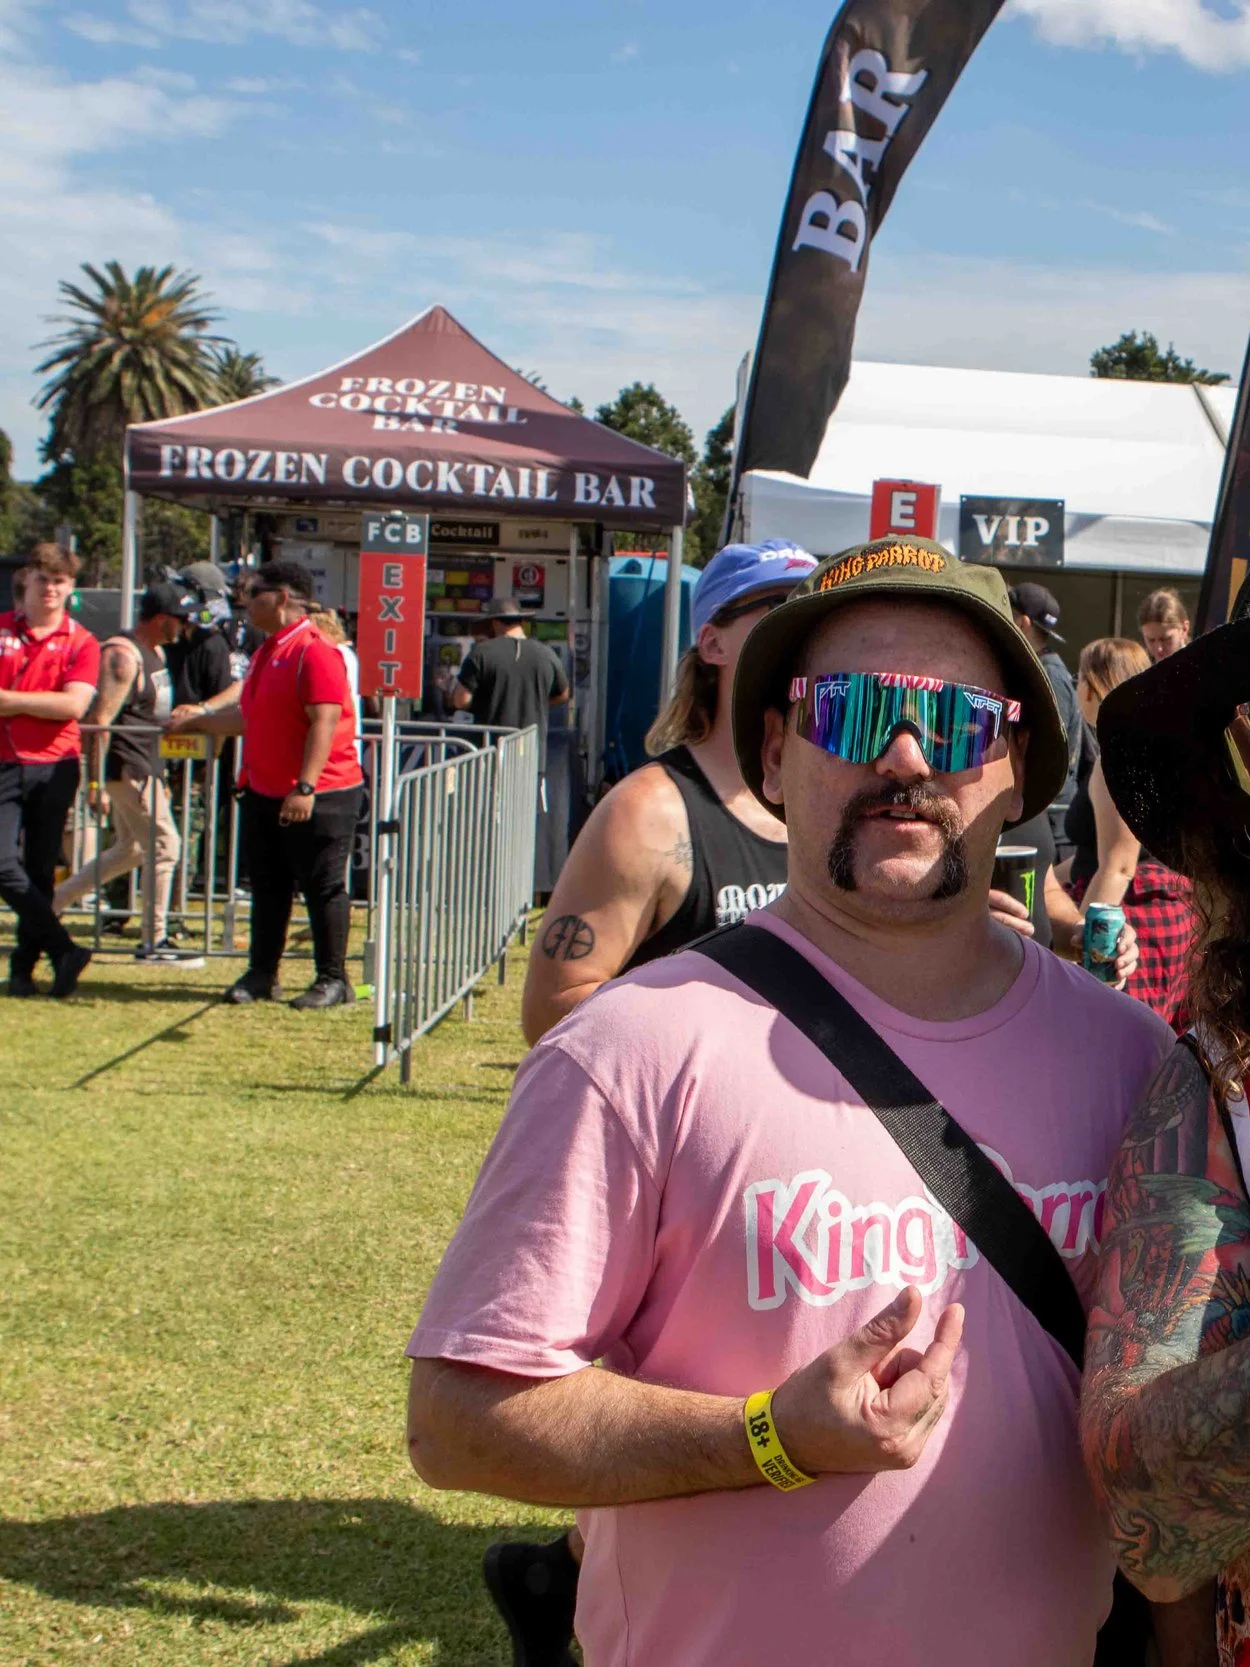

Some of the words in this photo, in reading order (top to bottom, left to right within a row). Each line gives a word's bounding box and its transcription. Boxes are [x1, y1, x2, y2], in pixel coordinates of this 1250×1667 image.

[791, 48, 928, 273] BAR
[308, 392, 528, 425] COCKTAIL
[339, 376, 507, 405] FROZEN
[372, 413, 459, 436] BAR
[158, 444, 329, 485] FROZEN
[341, 455, 559, 501] COCKTAIL
[573, 471, 657, 509] BAR
[431, 524, 494, 539] Cocktail
[888, 490, 918, 536] E
[972, 513, 1050, 547] VIP
[366, 521, 423, 545] FCB
[818, 556, 866, 594] KING
[864, 542, 945, 574] PARROT
[377, 561, 405, 687] EXIT
[750, 1173, 943, 1305] King
[749, 1410, 771, 1448] 18+
